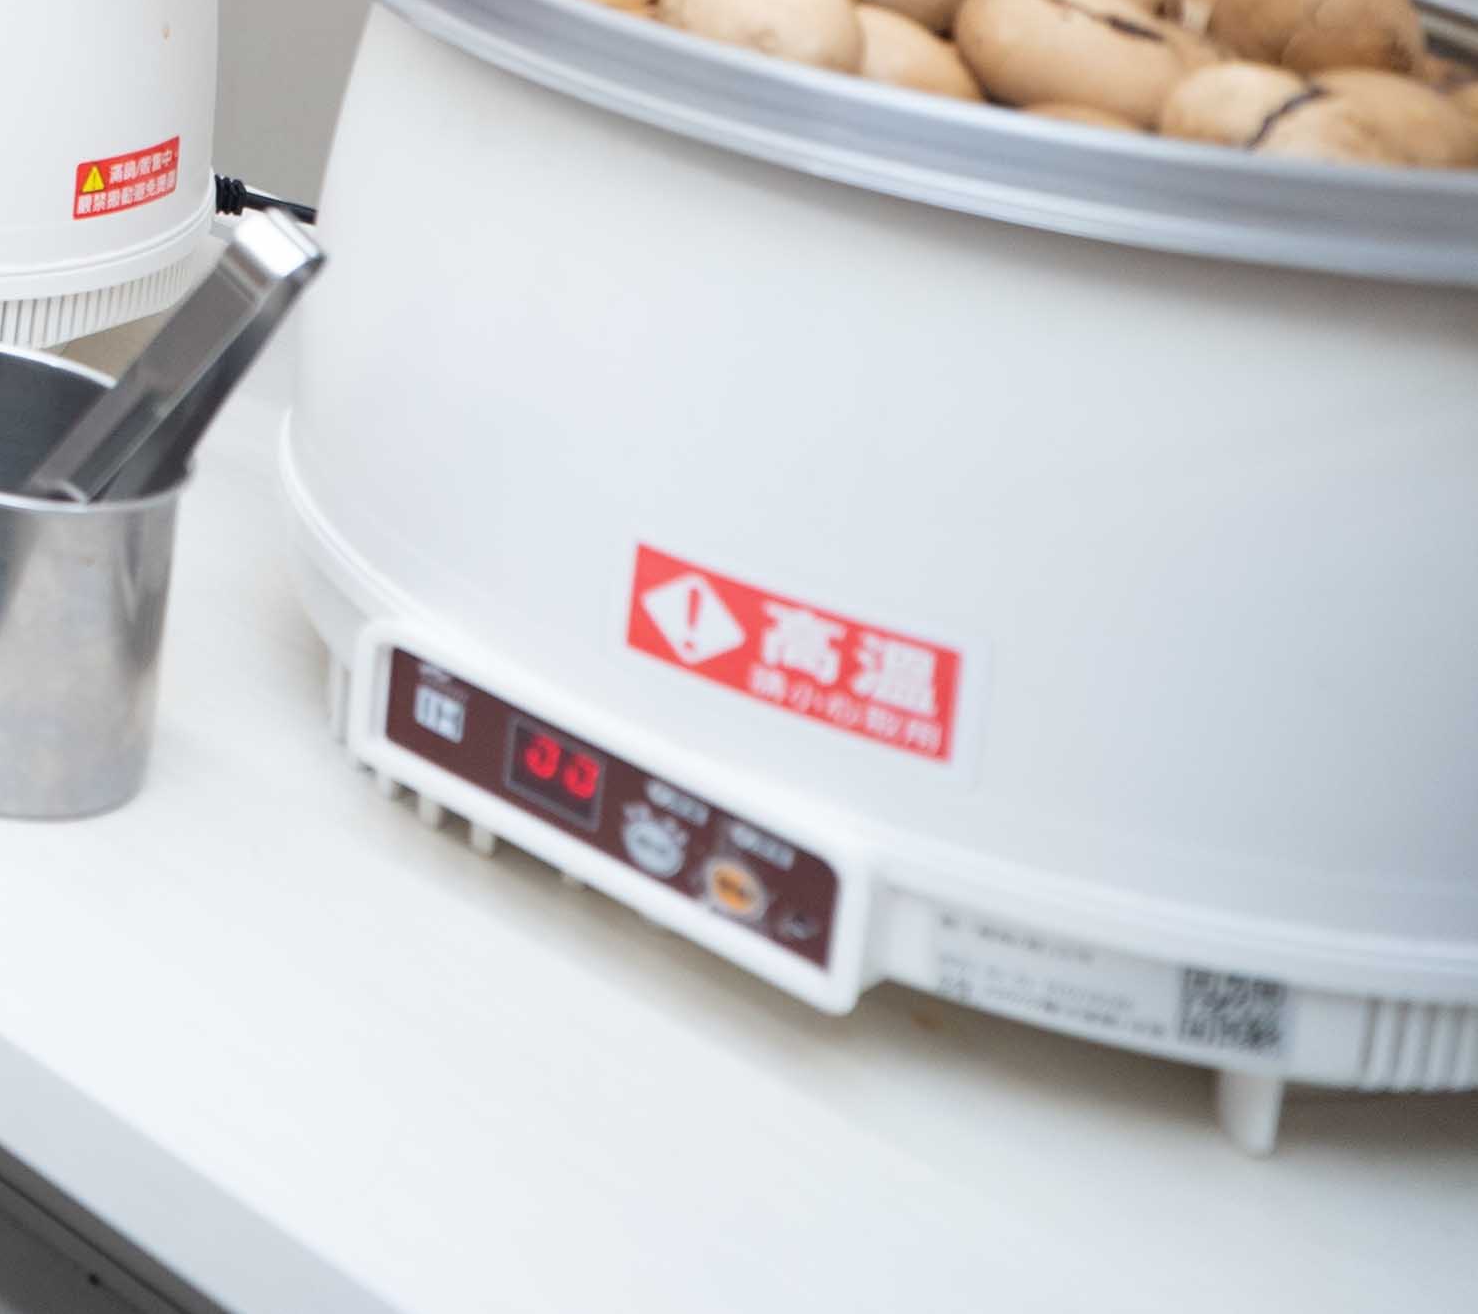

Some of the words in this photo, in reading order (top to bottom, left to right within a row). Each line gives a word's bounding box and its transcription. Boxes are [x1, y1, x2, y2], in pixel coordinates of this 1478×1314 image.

[749, 662, 944, 755] 請小心取用
[763, 599, 935, 715] 高溫
